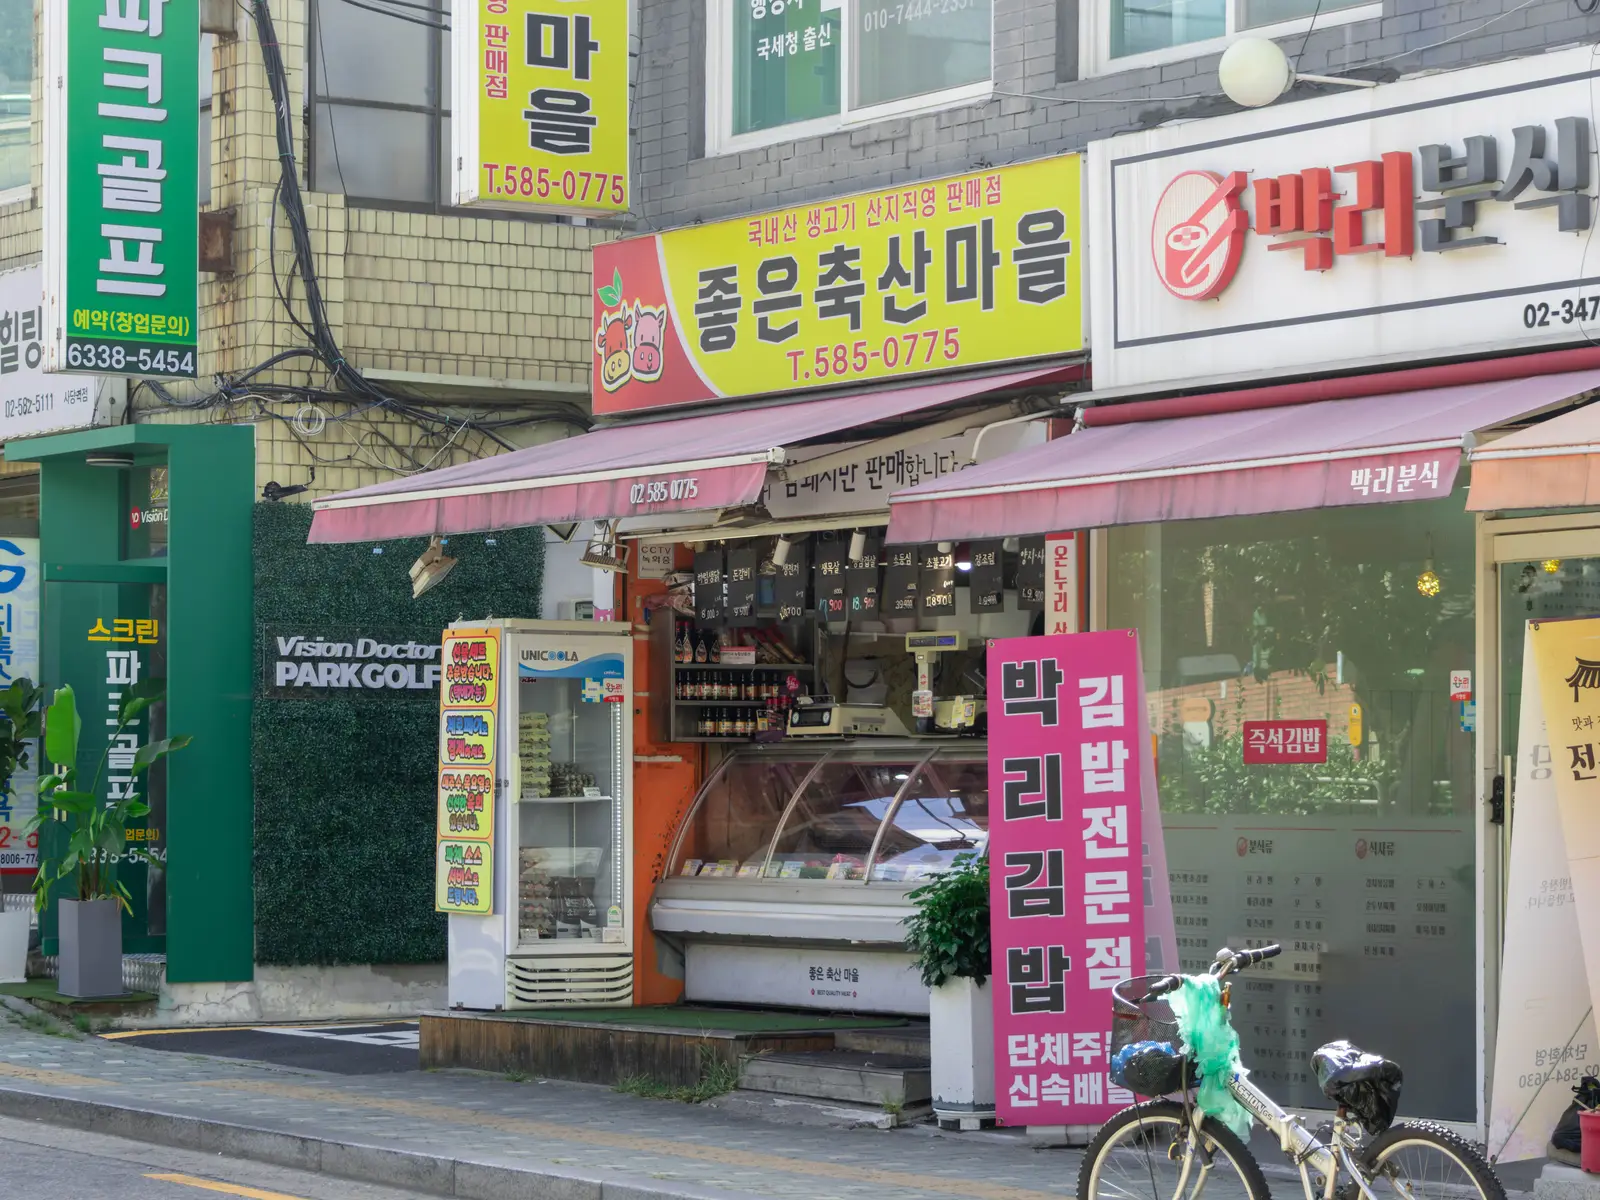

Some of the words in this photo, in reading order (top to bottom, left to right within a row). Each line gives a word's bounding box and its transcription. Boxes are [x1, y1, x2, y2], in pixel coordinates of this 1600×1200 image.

[756, 30, 798, 61] 국세청
[803, 22, 832, 52] 출신
[484, 24, 510, 100] 판매점
[523, 12, 600, 156] 마을
[483, 163, 625, 205] T.585-0775
[1252, 115, 1591, 273] 박리분식
[747, 216, 799, 249] 국내산
[807, 202, 857, 240] 생고기
[866, 185, 937, 229] 산지직영
[946, 174, 1002, 213] 판매점
[73, 308, 190, 338] 예약(창업문의)
[67, 343, 194, 374] 6338-5454
[786, 326, 961, 382] T.585-0775
[630, 483, 645, 504] 02
[646, 480, 668, 503] 585
[669, 477, 698, 501] 0775
[1350, 460, 1441, 497] 박리분식
[141, 509, 163, 523] Vision
[641, 546, 671, 555] CCTV
[926, 554, 952, 570] 소불고기
[975, 552, 996, 567] 장조림
[1053, 545, 1068, 613] 온누리
[88, 618, 159, 644] 스크린
[276, 636, 353, 658] Vision
[355, 638, 442, 660] Doctor
[1571, 714, 1594, 731] 맛과
[1248, 727, 1321, 755] 즉석김밥
[1566, 743, 1600, 781] 전
[1001, 657, 1072, 1016] 박리김밥
[1249, 839, 1273, 855] 분식류
[1368, 841, 1396, 857] 식사류
[808, 966, 825, 981] 좋은
[826, 966, 842, 982] 축산
[843, 967, 860, 983] 마을
[1007, 1031, 1112, 1067] 단체주
